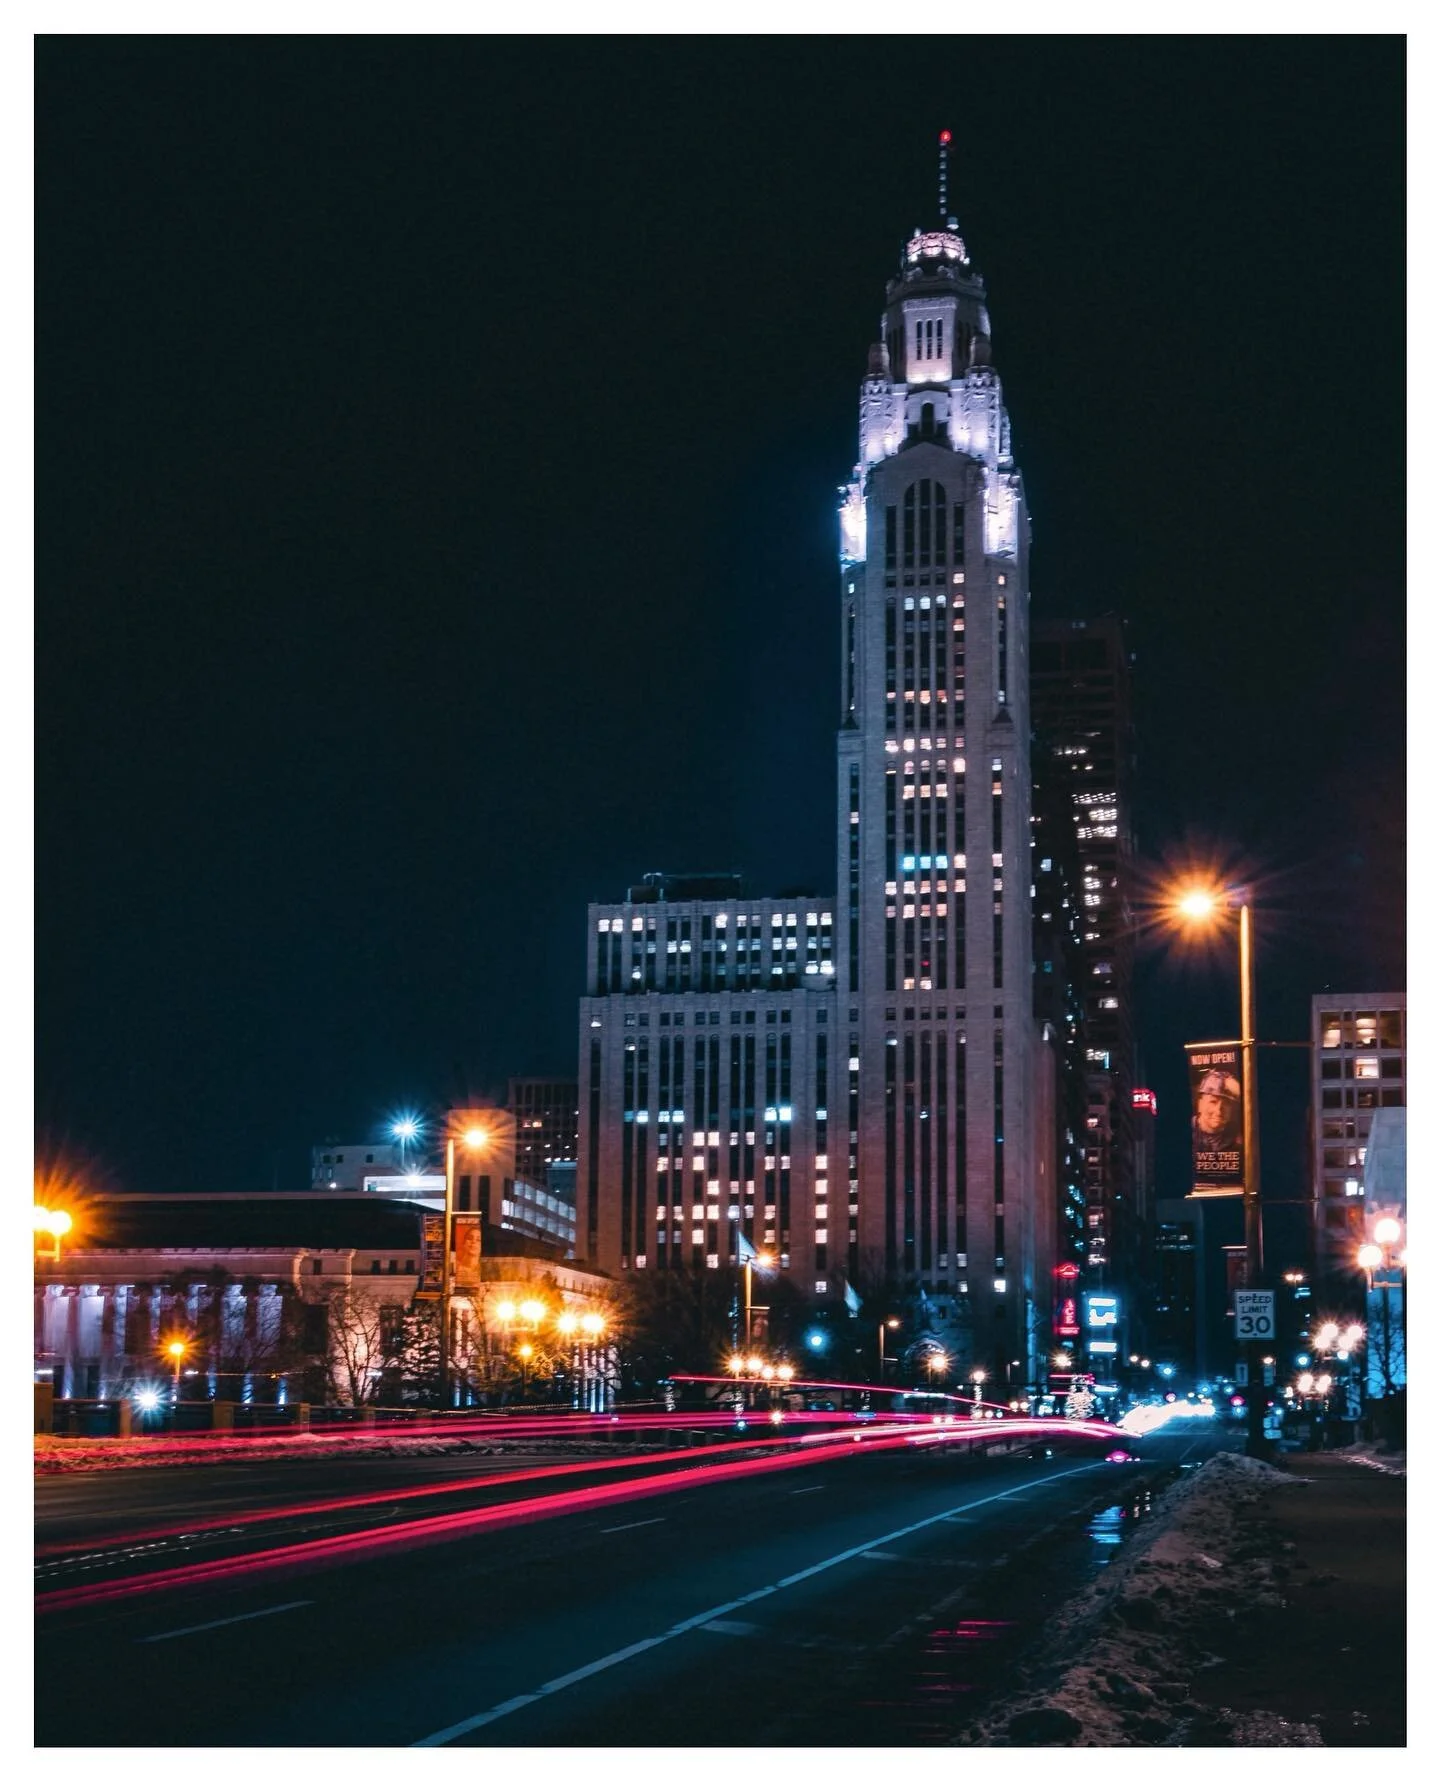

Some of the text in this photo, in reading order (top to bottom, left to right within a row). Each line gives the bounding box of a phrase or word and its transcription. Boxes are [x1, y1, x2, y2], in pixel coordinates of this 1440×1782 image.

[1191, 1055, 1211, 1066] NOW
[1196, 1151, 1240, 1161] WE THE
[1196, 1161, 1240, 1170] PEOPLE
[1238, 1295, 1273, 1304] SPEED
[1242, 1305, 1268, 1314] LIMIT
[1240, 1316, 1272, 1334] 30
